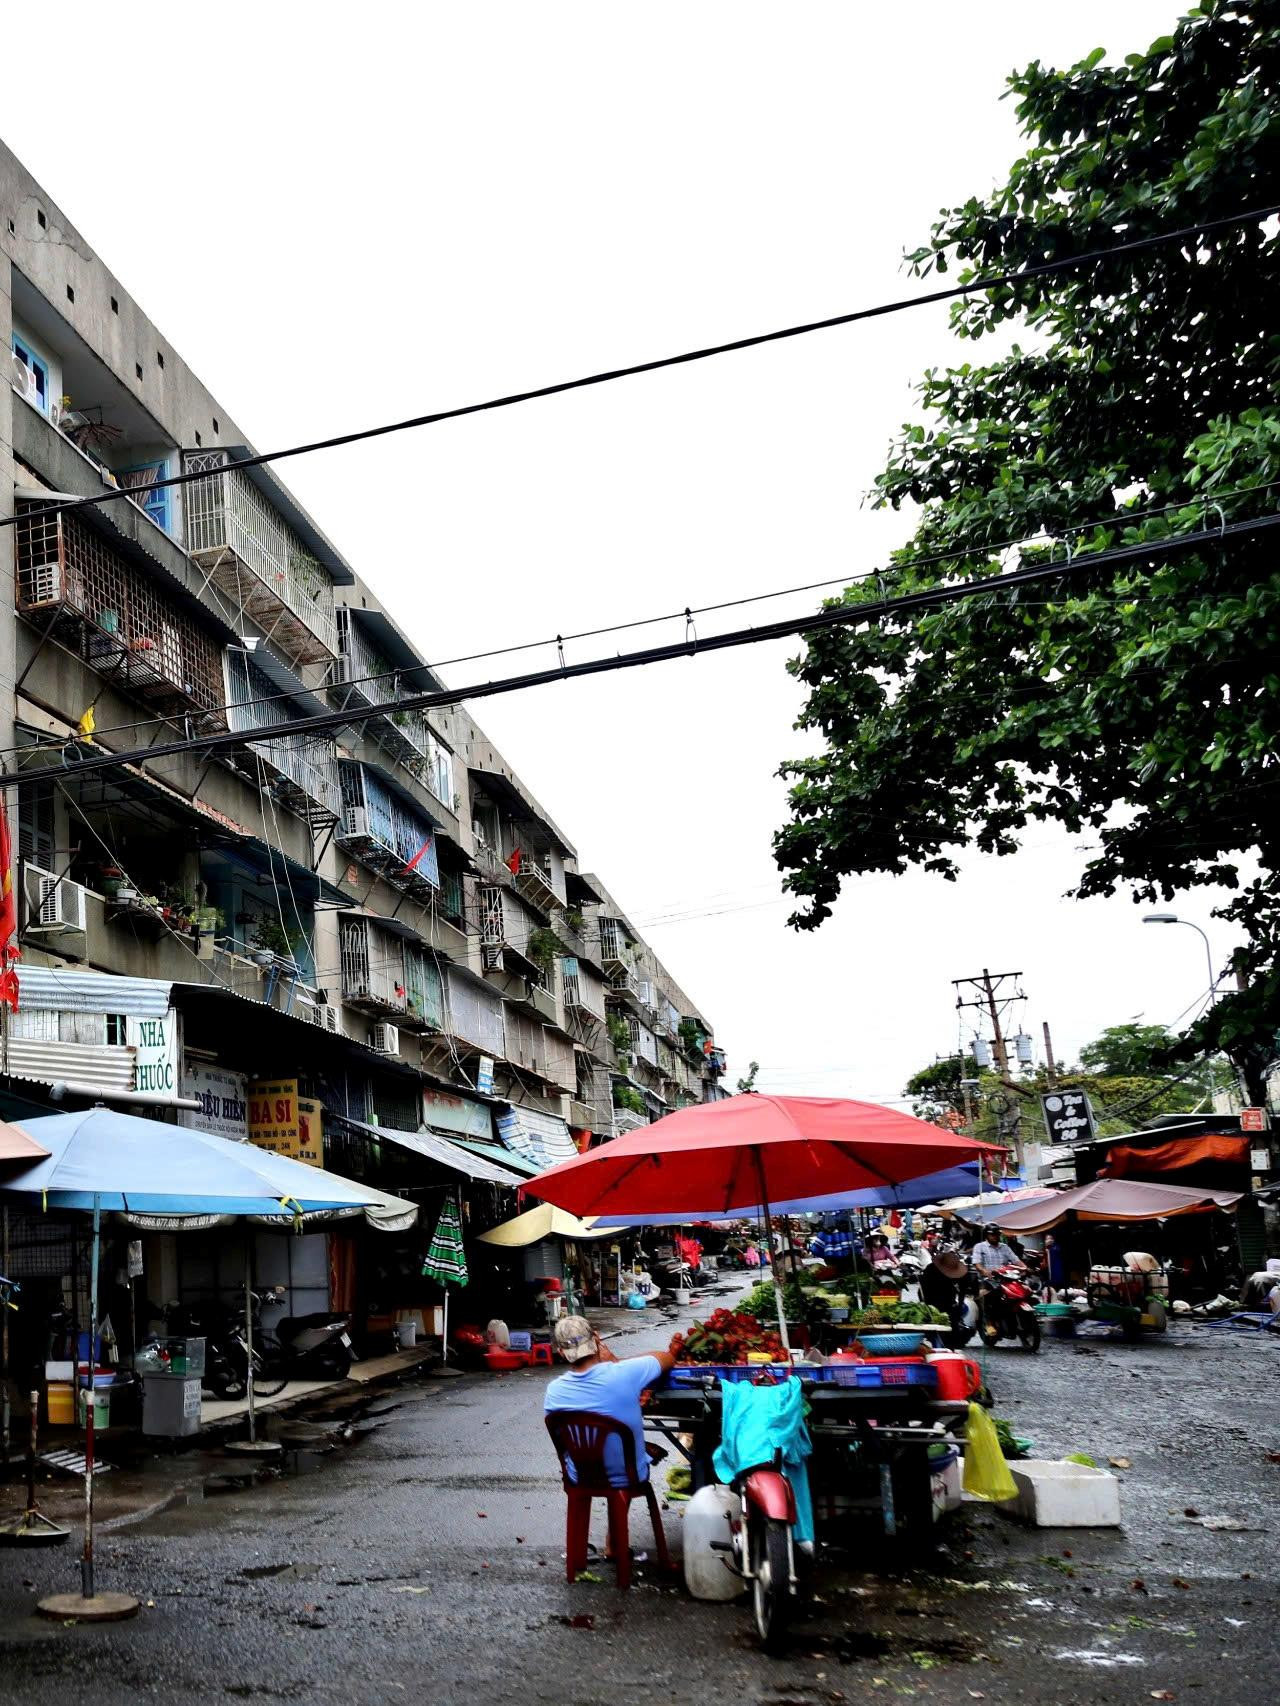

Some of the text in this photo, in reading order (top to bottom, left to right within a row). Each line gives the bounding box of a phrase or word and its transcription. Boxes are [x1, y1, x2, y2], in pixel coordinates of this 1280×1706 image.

[134, 1053, 173, 1091] THUỐC
[222, 1088, 246, 1122] HIỀN
[250, 1100, 273, 1124] BA
[276, 1099, 291, 1123] SI
[1054, 1117, 1087, 1129] Coffee
